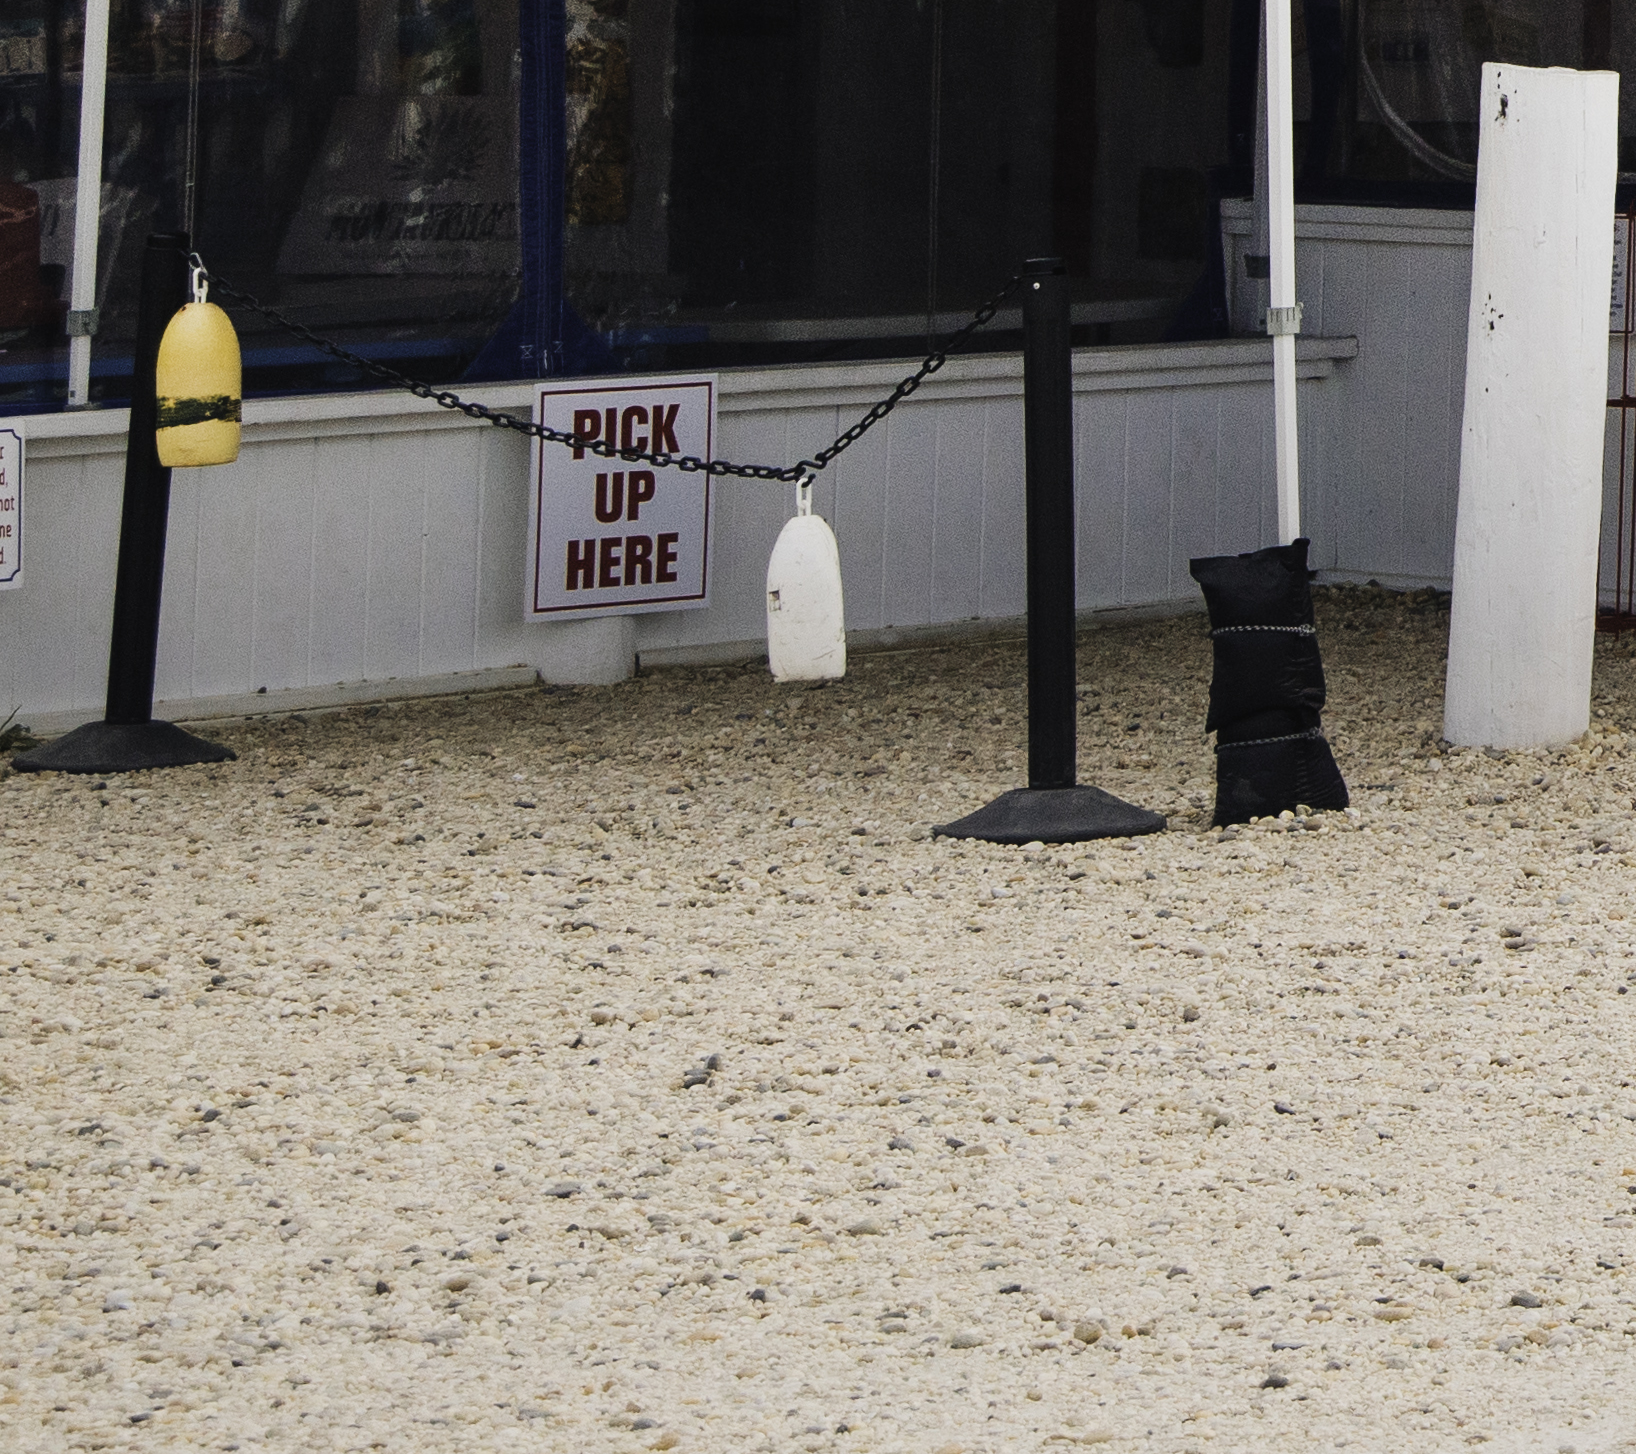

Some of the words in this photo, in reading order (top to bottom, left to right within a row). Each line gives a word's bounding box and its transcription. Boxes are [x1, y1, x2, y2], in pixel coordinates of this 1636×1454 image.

[572, 403, 681, 460] PICK
[594, 470, 656, 524] UP
[565, 532, 679, 591] HERE
